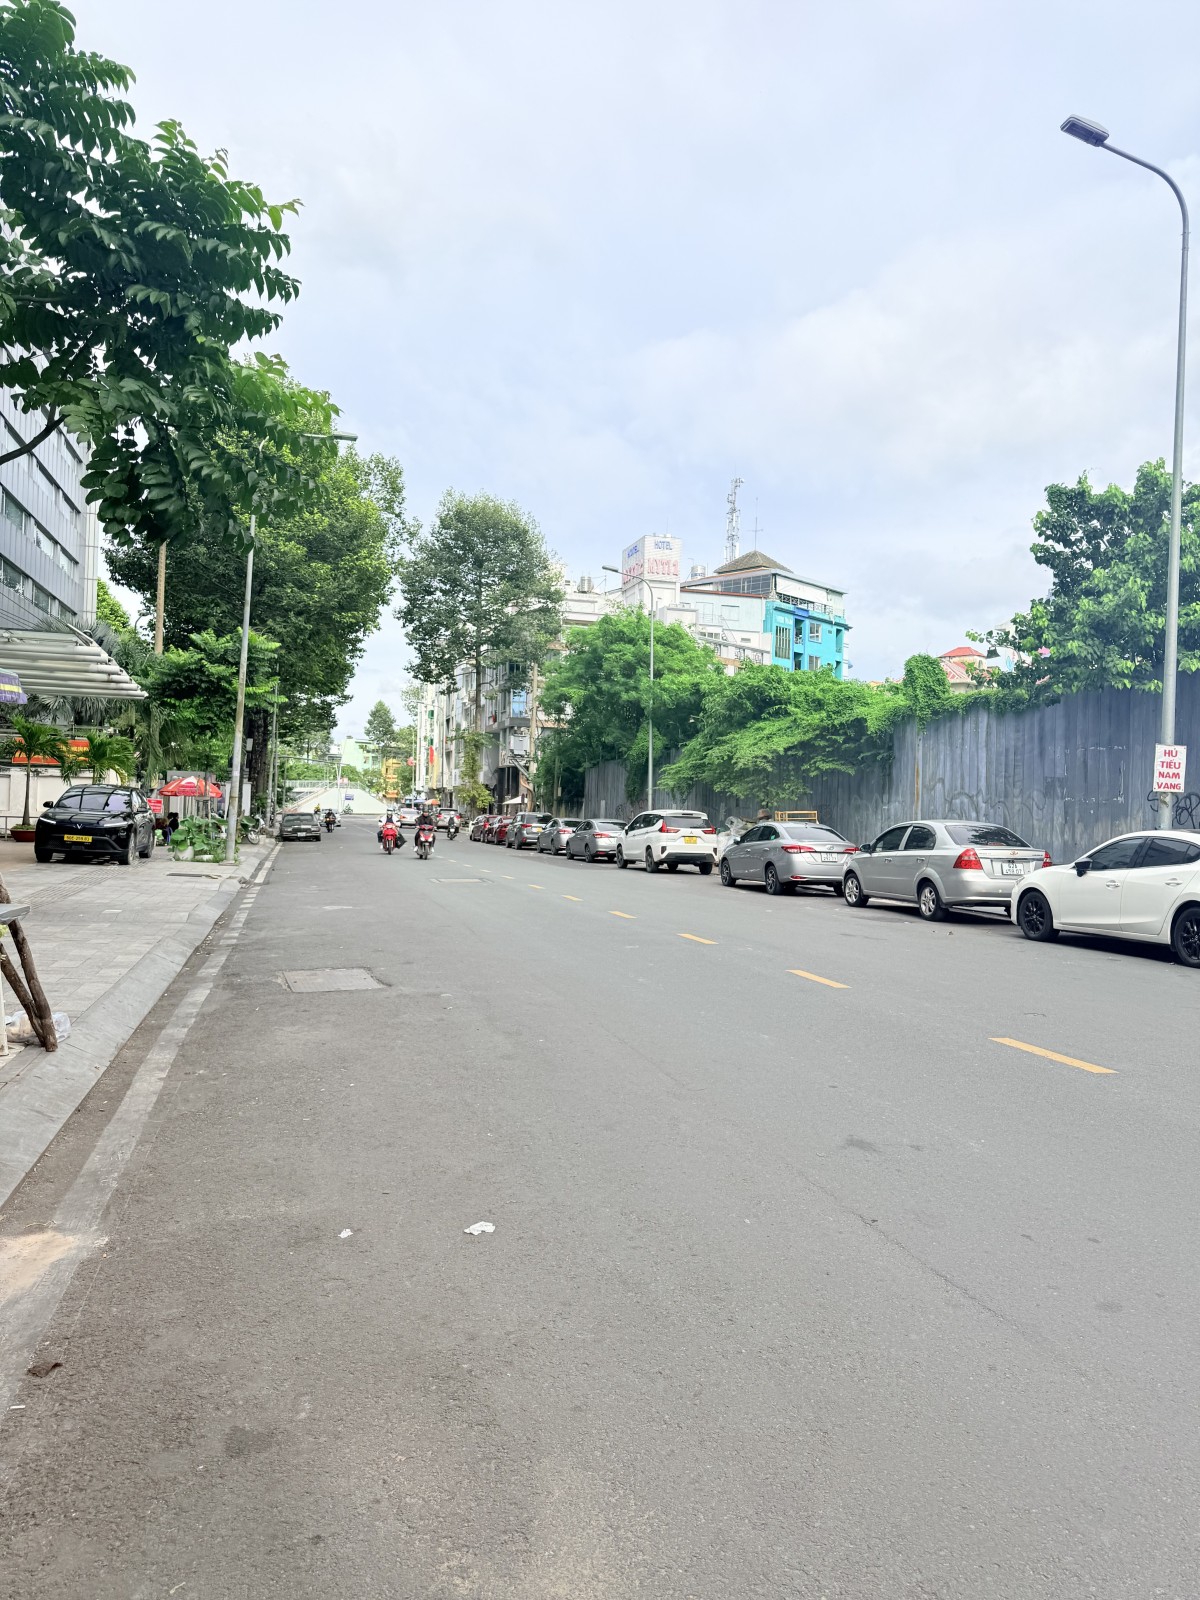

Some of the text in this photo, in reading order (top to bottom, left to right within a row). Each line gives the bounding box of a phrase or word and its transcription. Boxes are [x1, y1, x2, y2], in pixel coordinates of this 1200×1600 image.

[655, 540, 673, 550] HOTEL
[1158, 771, 1181, 779] NAM
[1157, 782, 1181, 790] VANG
